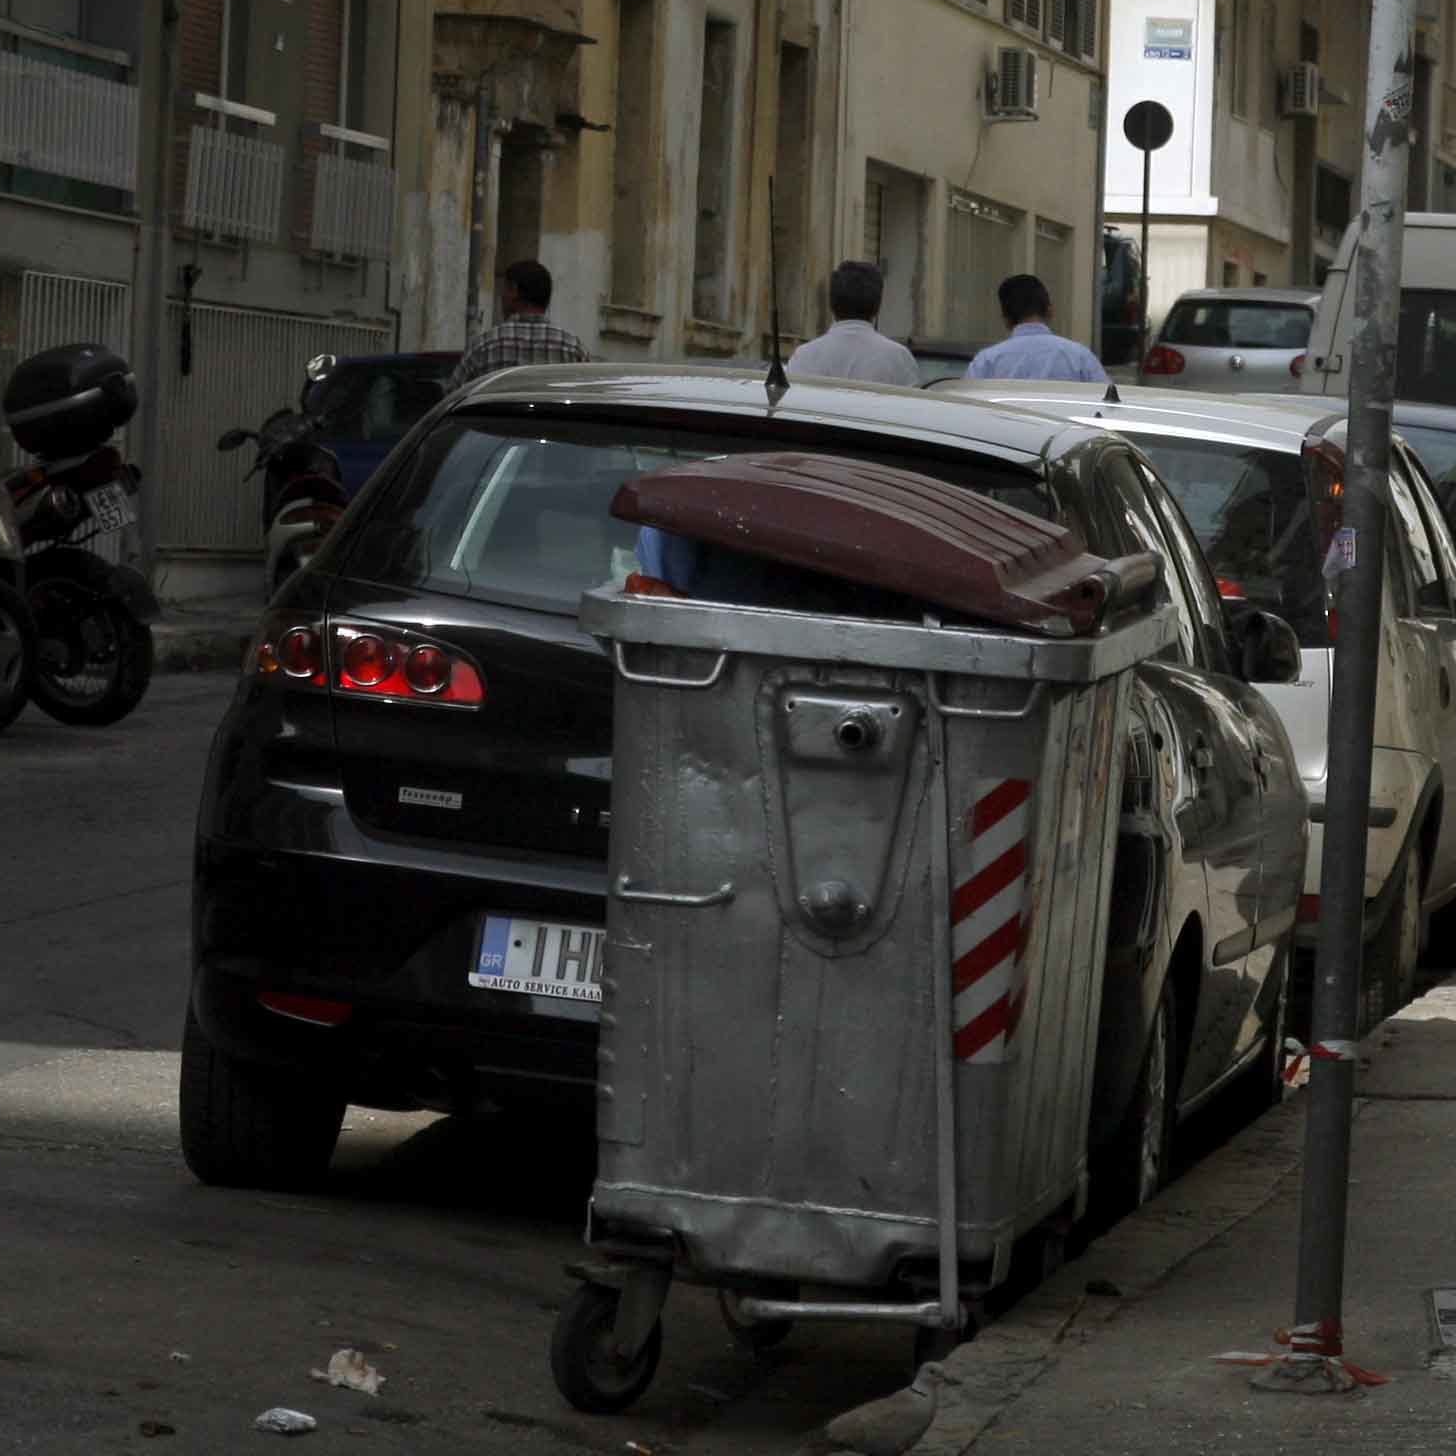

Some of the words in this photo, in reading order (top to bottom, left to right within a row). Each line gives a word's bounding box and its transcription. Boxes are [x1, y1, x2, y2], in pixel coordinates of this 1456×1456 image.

[480, 952, 504, 970] GR
[490, 977, 521, 991] AUTO
[524, 981, 570, 996] SERVICE
